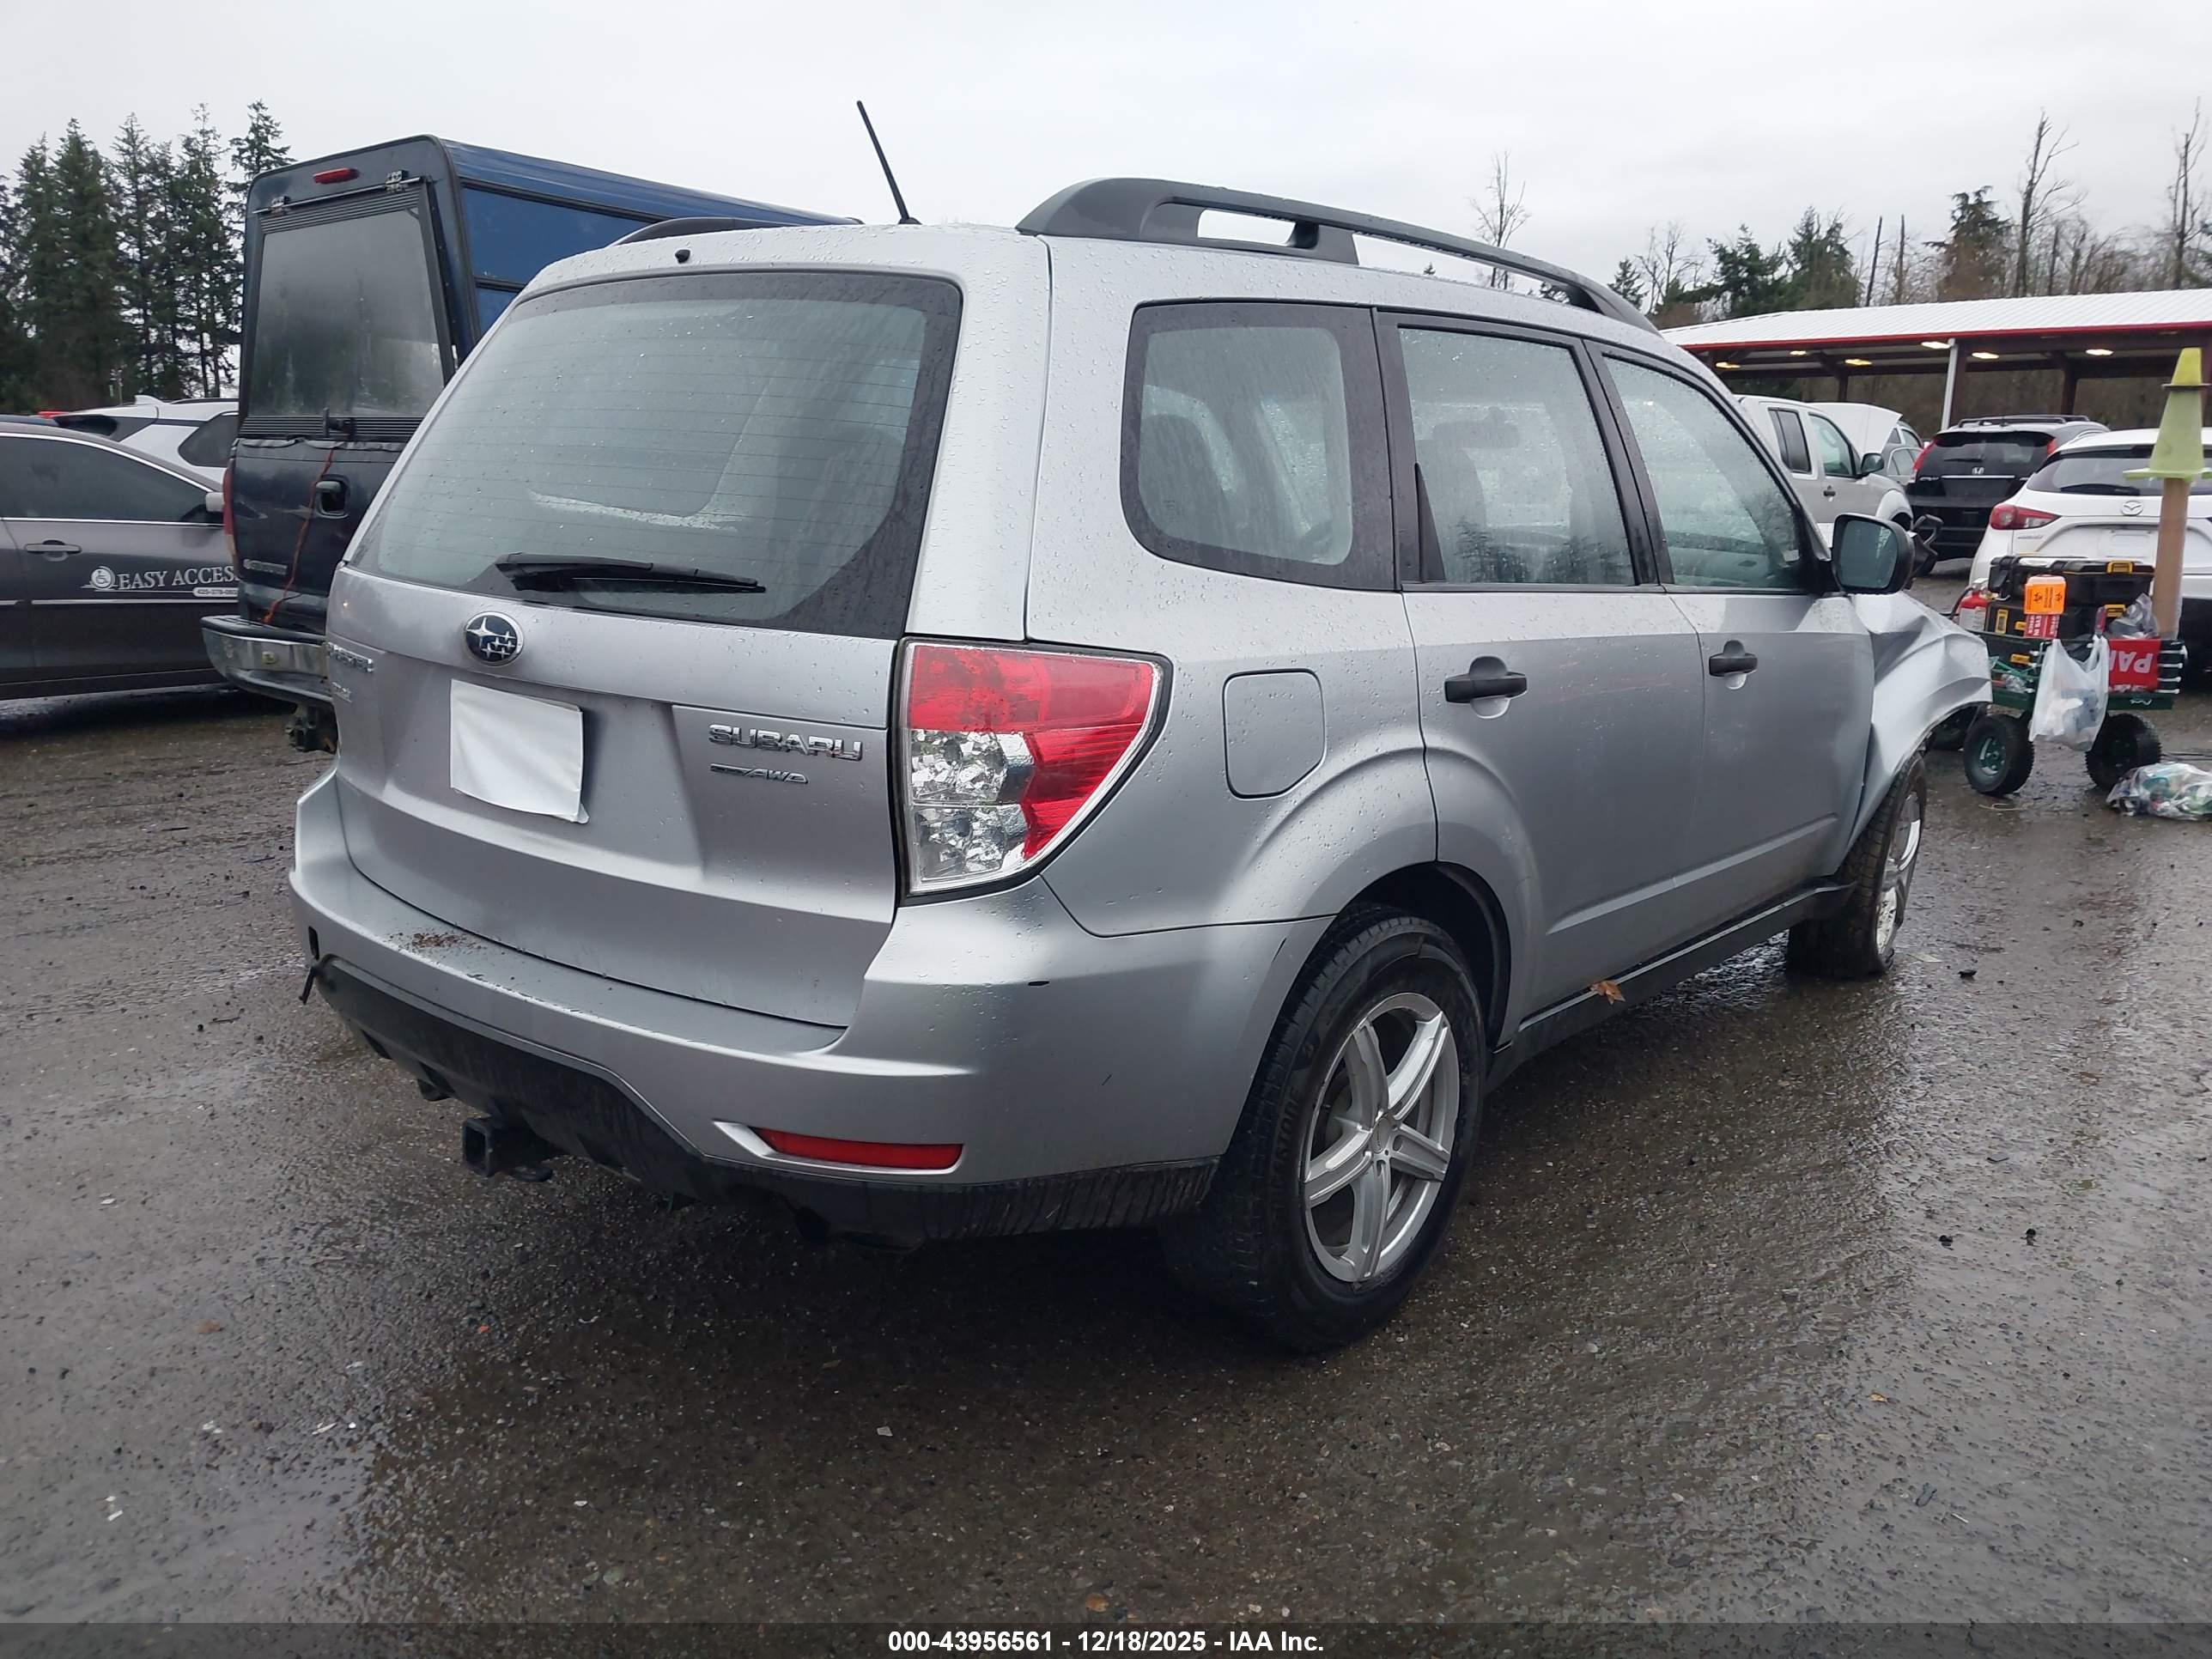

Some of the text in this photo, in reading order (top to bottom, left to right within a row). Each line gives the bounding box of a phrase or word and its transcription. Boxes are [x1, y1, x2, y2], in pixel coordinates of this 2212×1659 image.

[118, 571, 167, 590] EASY
[708, 724, 863, 762] SUBARU
[744, 768, 809, 784] AWD
